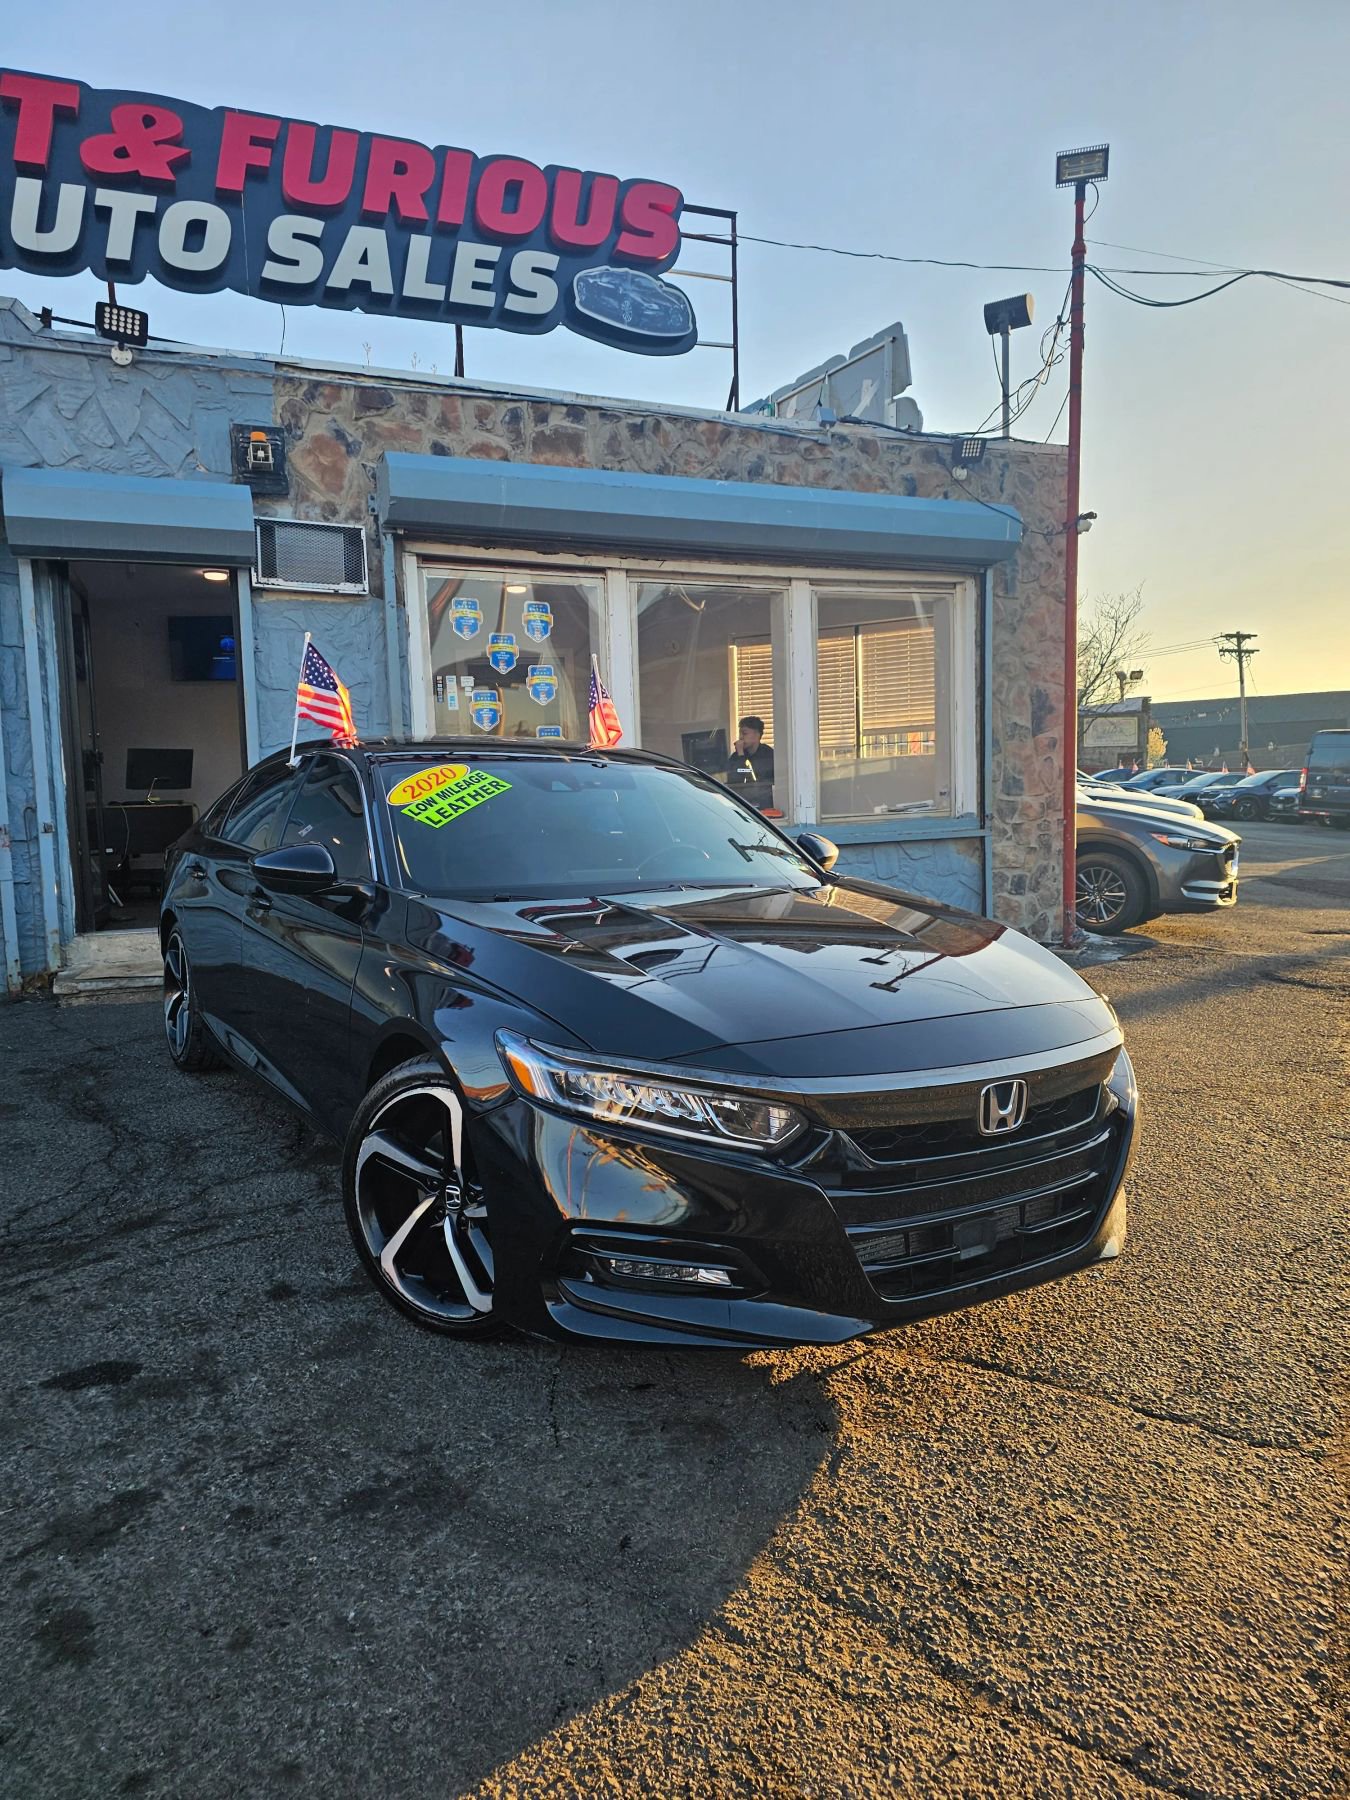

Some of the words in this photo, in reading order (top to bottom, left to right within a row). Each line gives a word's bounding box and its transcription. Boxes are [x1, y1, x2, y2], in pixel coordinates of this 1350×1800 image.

[80, 103, 192, 181] &
[215, 111, 682, 260] FURIOUS
[10, 177, 232, 271] UTO
[261, 214, 560, 315] SALES
[402, 767, 457, 800] 2020
[408, 796, 437, 817] LOW
[435, 772, 488, 800] MILEAGE
[425, 780, 507, 825] LEATHER
